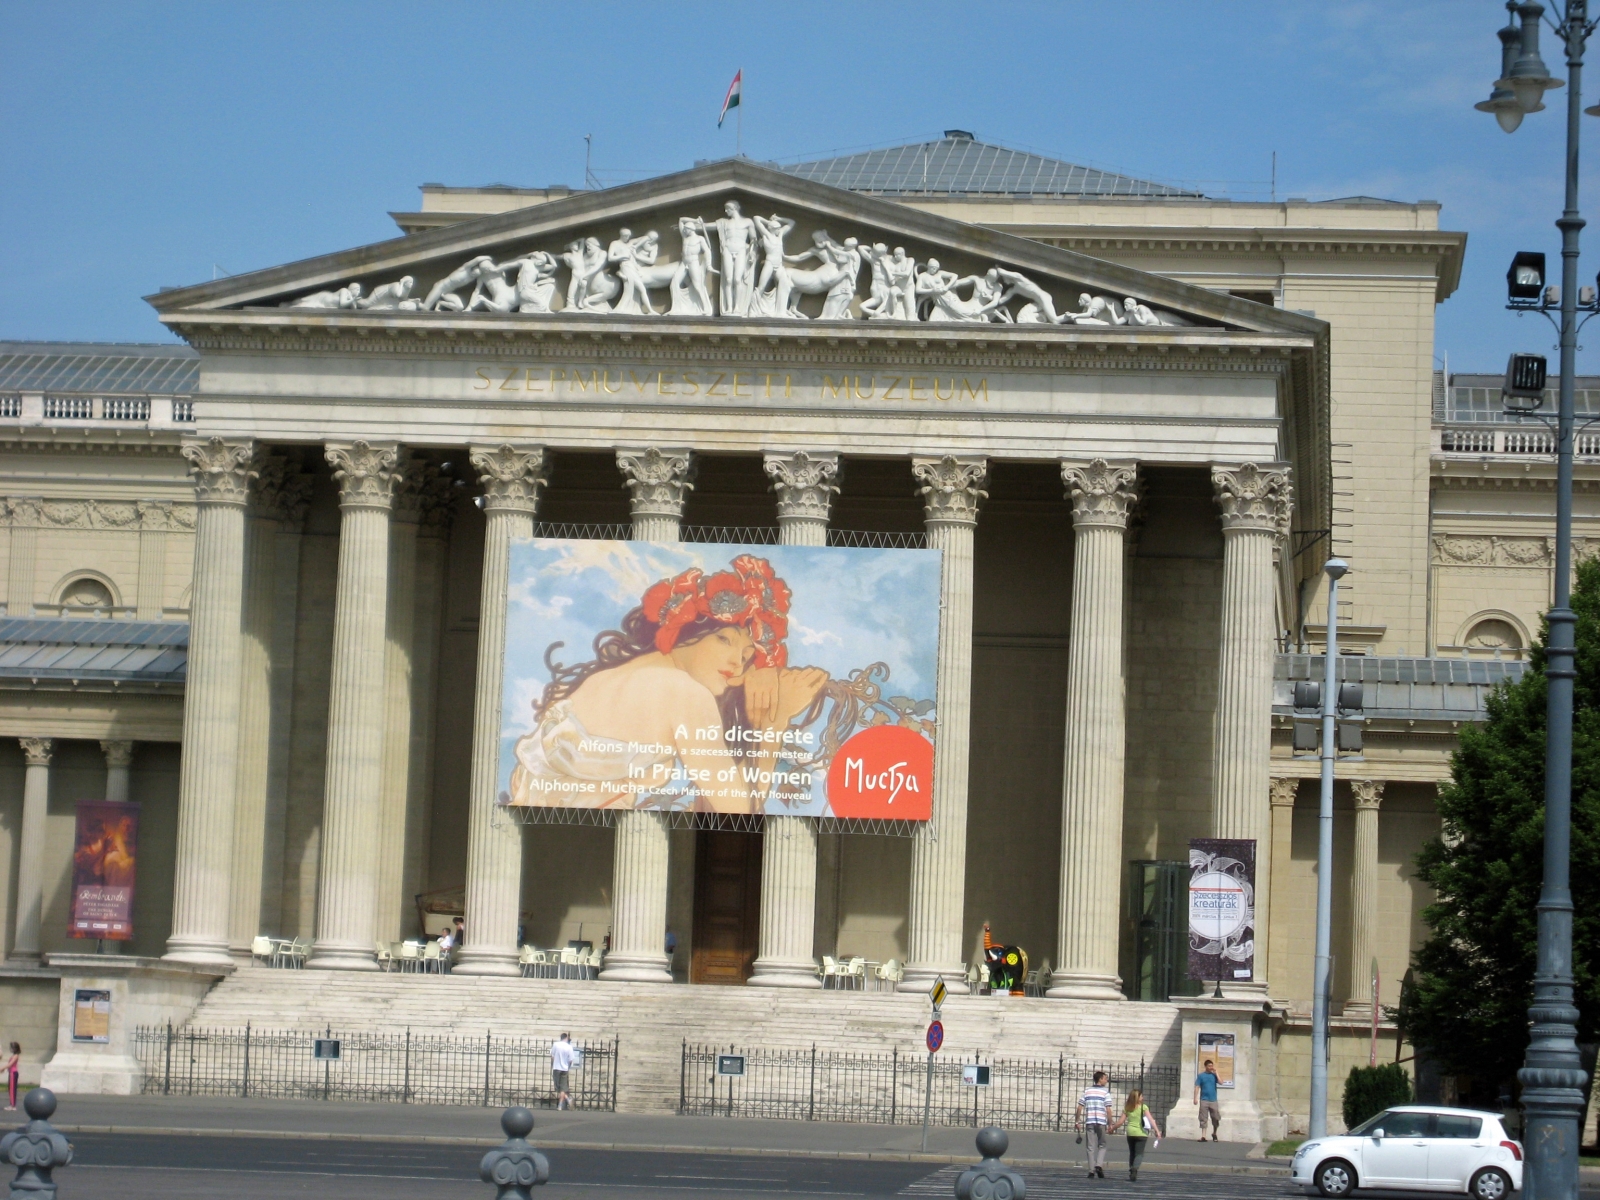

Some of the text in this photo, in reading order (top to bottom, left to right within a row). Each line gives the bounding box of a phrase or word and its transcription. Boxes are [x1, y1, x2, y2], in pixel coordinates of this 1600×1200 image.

[820, 374, 989, 402] MUZEUM
[674, 723, 814, 745] A nő dicsérete
[577, 740, 623, 753] Alfons
[627, 741, 677, 756] Mucha,
[690, 747, 743, 757] szecesszió
[745, 748, 769, 758] cseh
[772, 750, 814, 760] mestere
[628, 762, 812, 785] In Praise of Women
[529, 778, 812, 800] Alphonse Mucha Czech Master of the Art Nouveau
